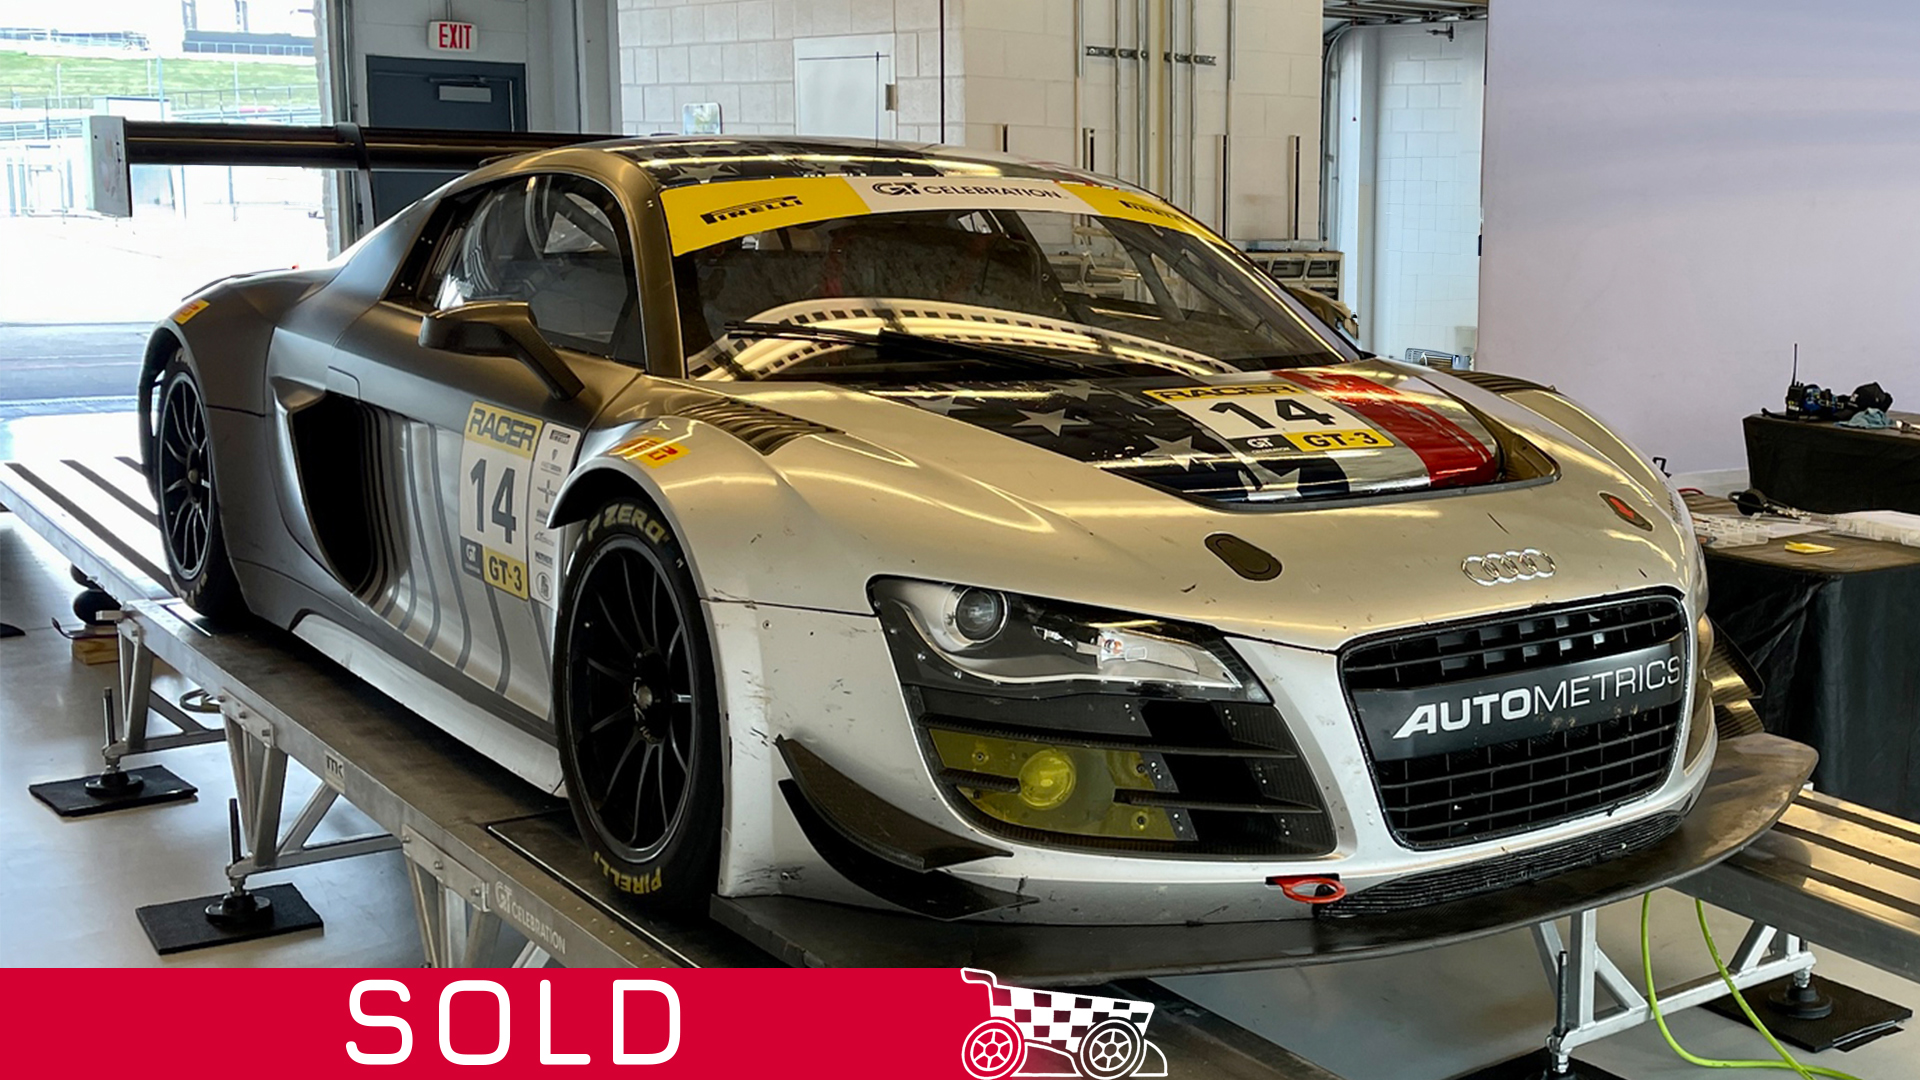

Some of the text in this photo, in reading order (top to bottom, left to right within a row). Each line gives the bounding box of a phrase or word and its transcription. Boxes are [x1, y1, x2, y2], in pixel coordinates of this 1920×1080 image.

[438, 23, 472, 50] EXIT
[872, 181, 1062, 200] GT CELEBRATION
[700, 194, 803, 225] PIRELLI
[1154, 385, 1299, 400] RACER
[468, 406, 537, 452] RACER
[1209, 399, 1337, 430] 14
[1246, 437, 1275, 449] GT
[1302, 431, 1379, 448] GT-3
[470, 458, 517, 544] 14
[587, 512, 601, 542] P
[603, 503, 666, 544] ZERO
[488, 555, 523, 592] GT-3
[1392, 655, 1681, 740] AUTOMETRICS
[592, 850, 664, 895] PIRELLI
[494, 880, 567, 955] GT CELEBRATION
